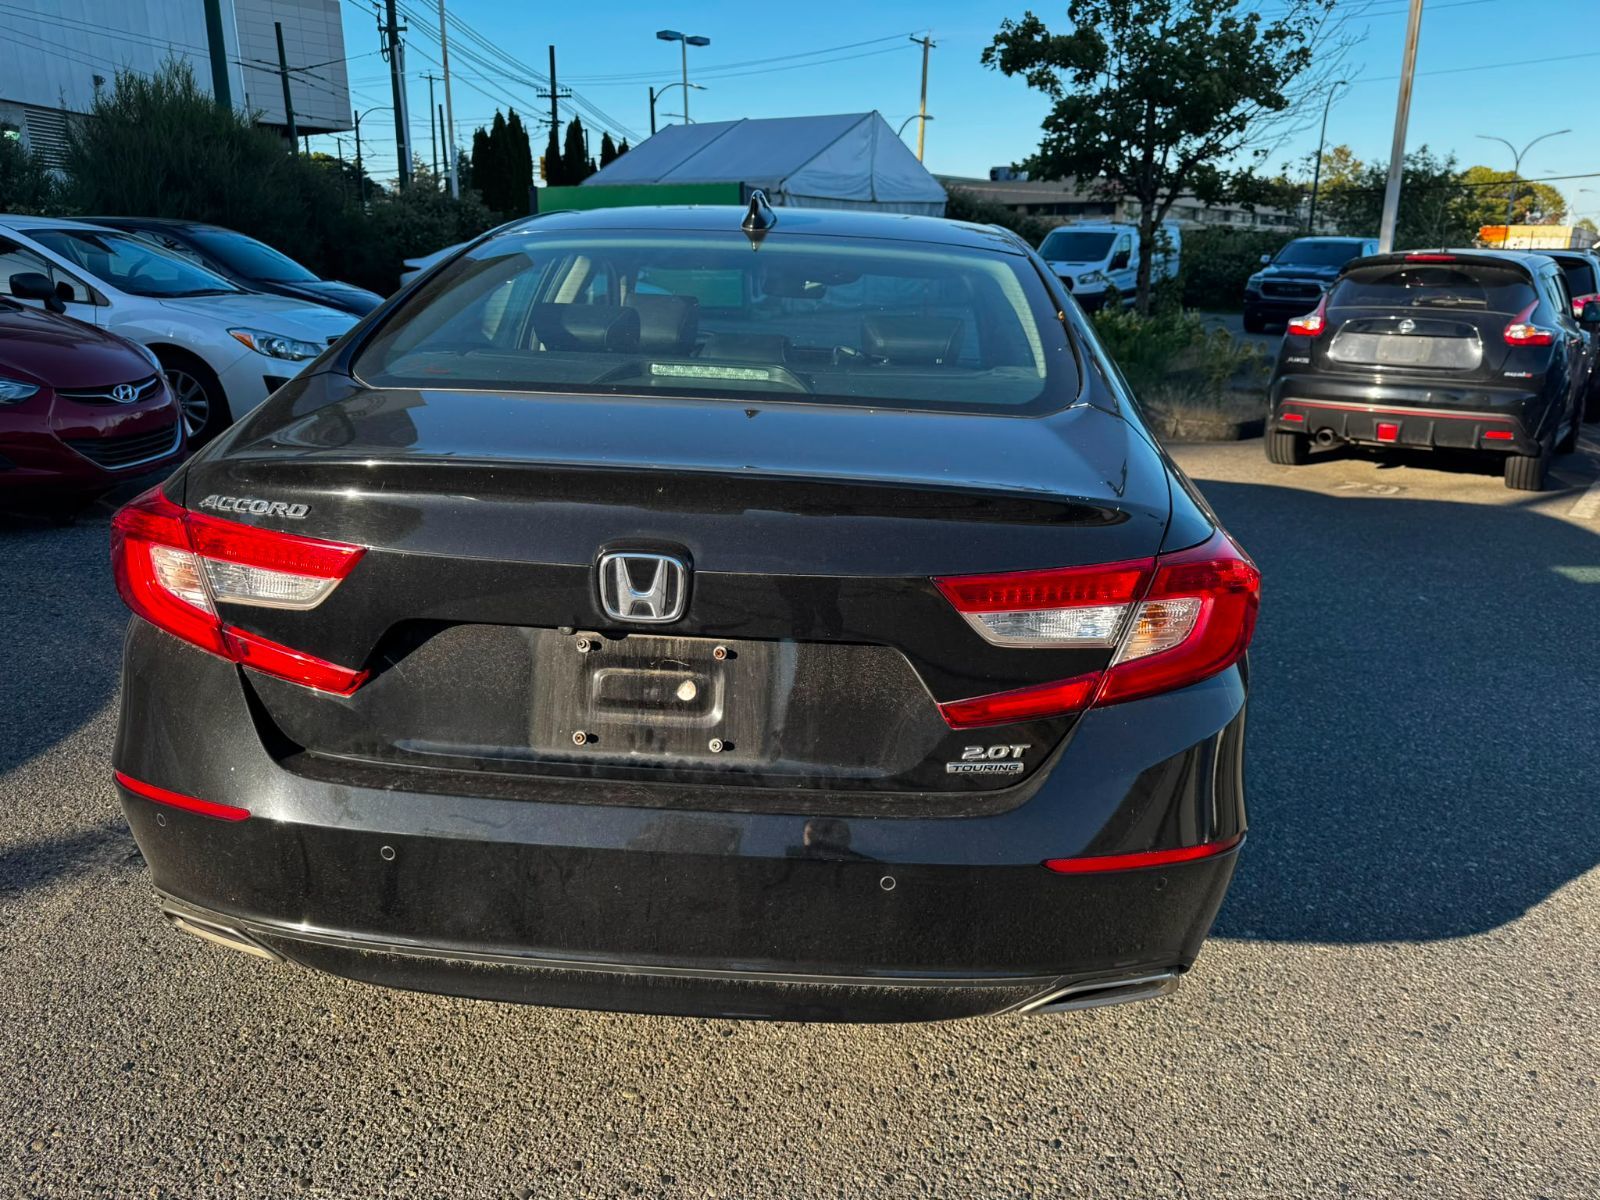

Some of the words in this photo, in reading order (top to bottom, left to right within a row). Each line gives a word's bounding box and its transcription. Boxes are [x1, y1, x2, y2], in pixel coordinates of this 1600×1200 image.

[198, 494, 311, 519] ACCORD
[962, 744, 1031, 760] 2.0T
[949, 763, 1020, 772] TOURING
